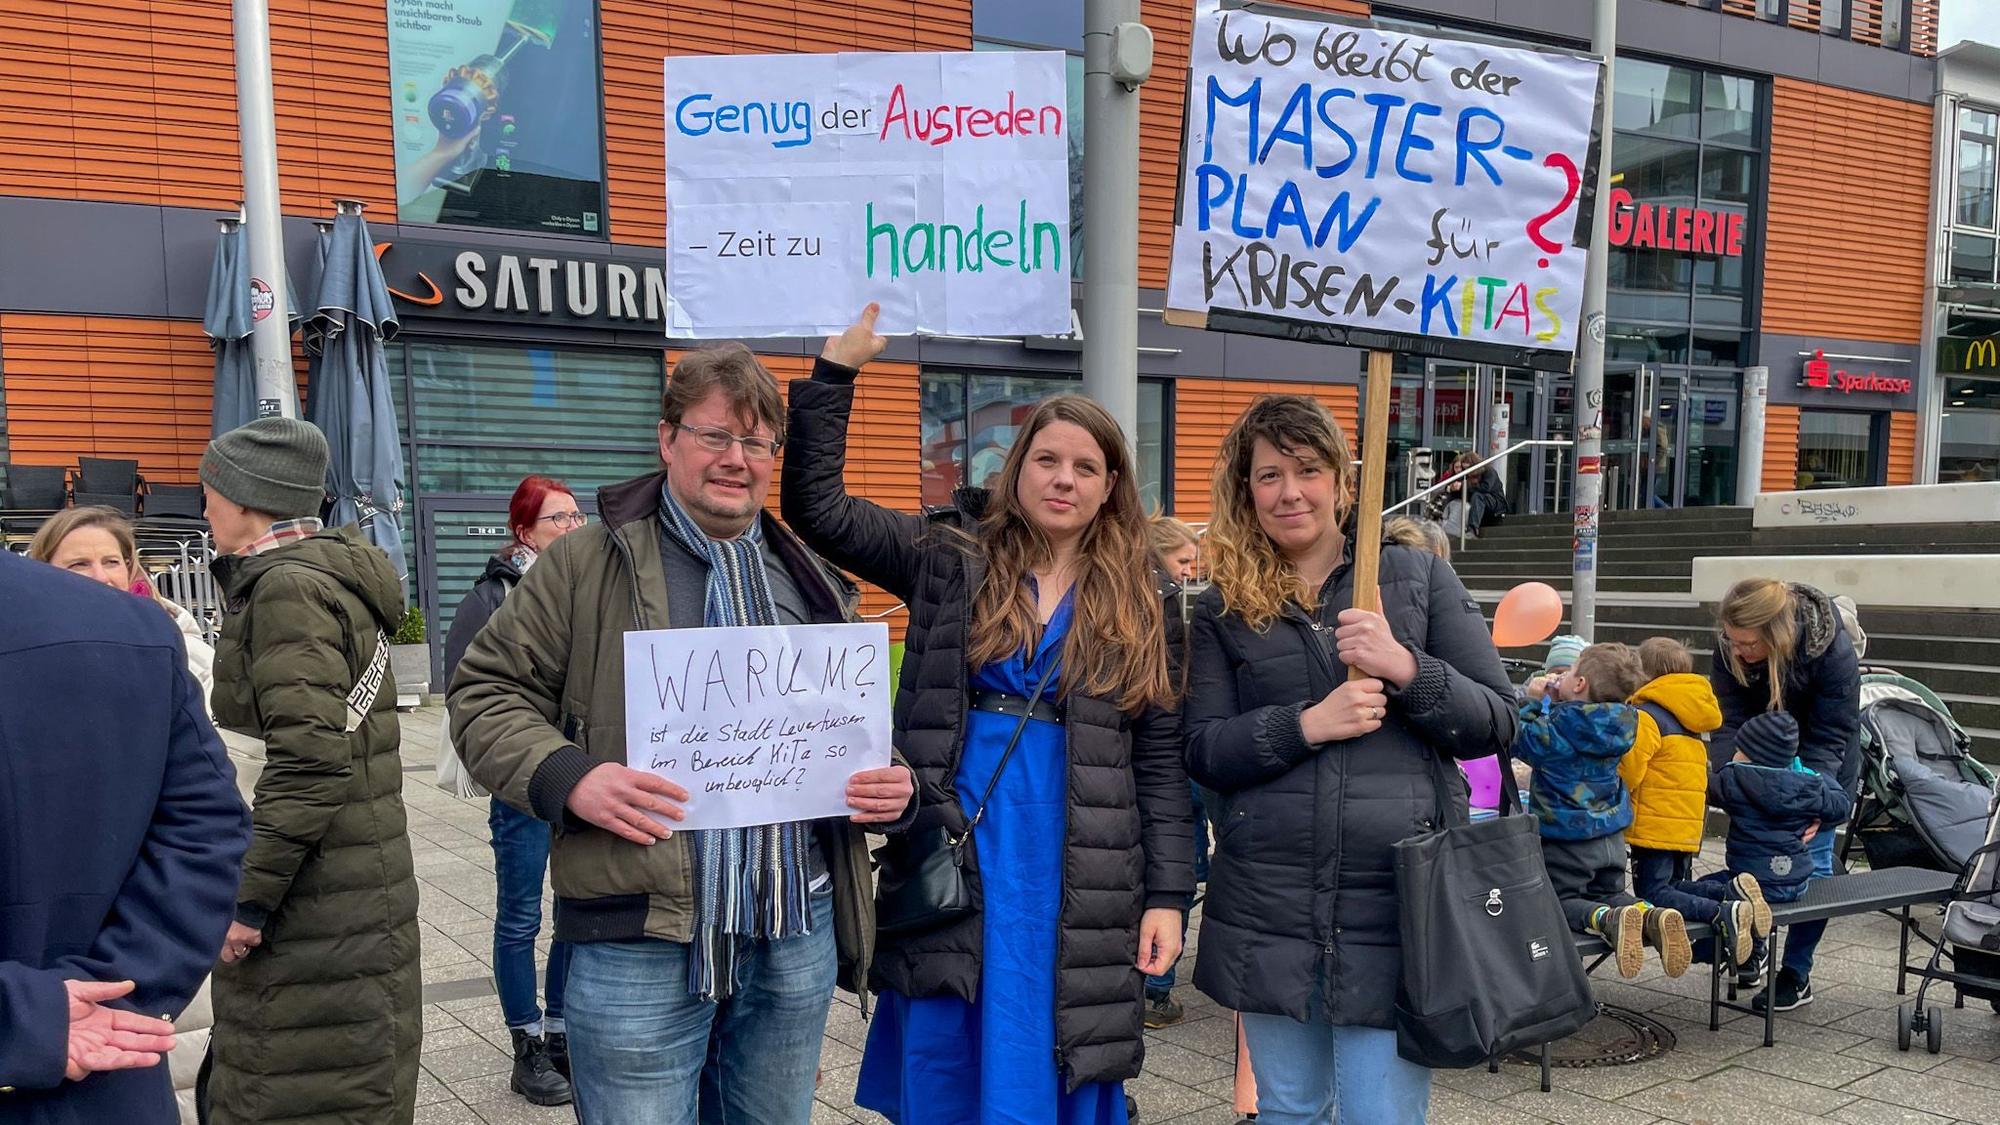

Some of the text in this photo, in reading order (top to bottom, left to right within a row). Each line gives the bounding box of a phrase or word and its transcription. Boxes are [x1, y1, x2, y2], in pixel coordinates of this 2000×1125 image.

[394, 9, 483, 27] unsichtbaren Staub
[394, 19, 432, 32] sichtbar
[1217, 13, 1522, 96] Wo bleibt der
[676, 83, 1062, 149] Genug der Ausreden
[1203, 75, 1534, 187] MASTER-
[717, 230, 776, 258] Zeit
[787, 236, 821, 257] zu
[866, 199, 1062, 283] handeln
[1195, 164, 1382, 254] PLAN
[1425, 207, 1501, 266] für
[1607, 187, 1745, 257] GALERIE
[1203, 240, 1562, 343] KRISEN-KITAS
[1835, 370, 1912, 395] Sparkasse
[651, 644, 876, 713] WARUM?
[650, 708, 866, 745] ist die Stadt Leverkusen
[651, 739, 848, 772] im Bereich KiTa so
